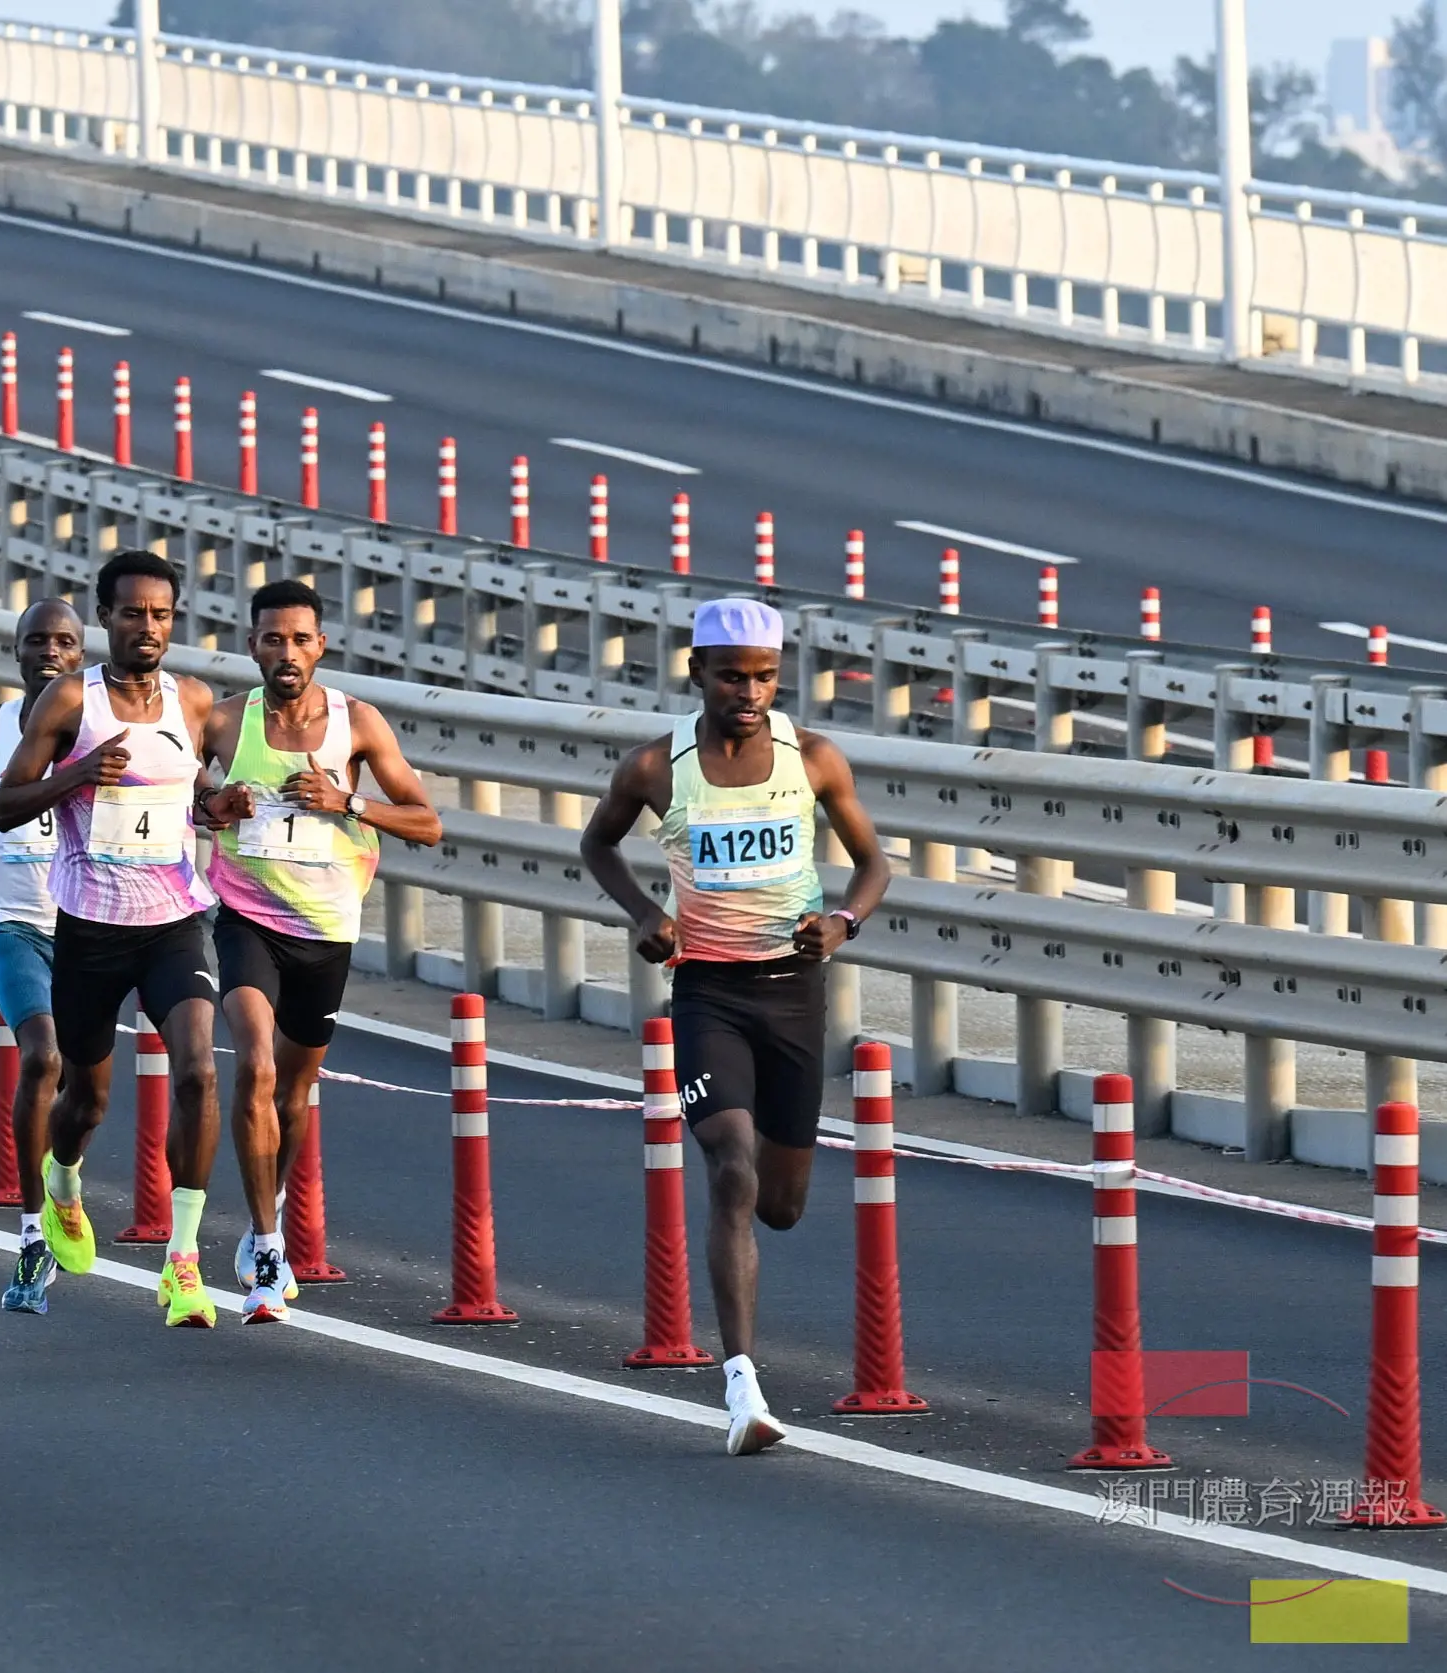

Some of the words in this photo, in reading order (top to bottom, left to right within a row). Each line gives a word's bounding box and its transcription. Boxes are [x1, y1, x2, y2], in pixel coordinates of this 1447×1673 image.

[39, 809, 53, 837] 9
[135, 811, 150, 840] 4
[283, 813, 295, 843] 1
[698, 824, 794, 864] A1205
